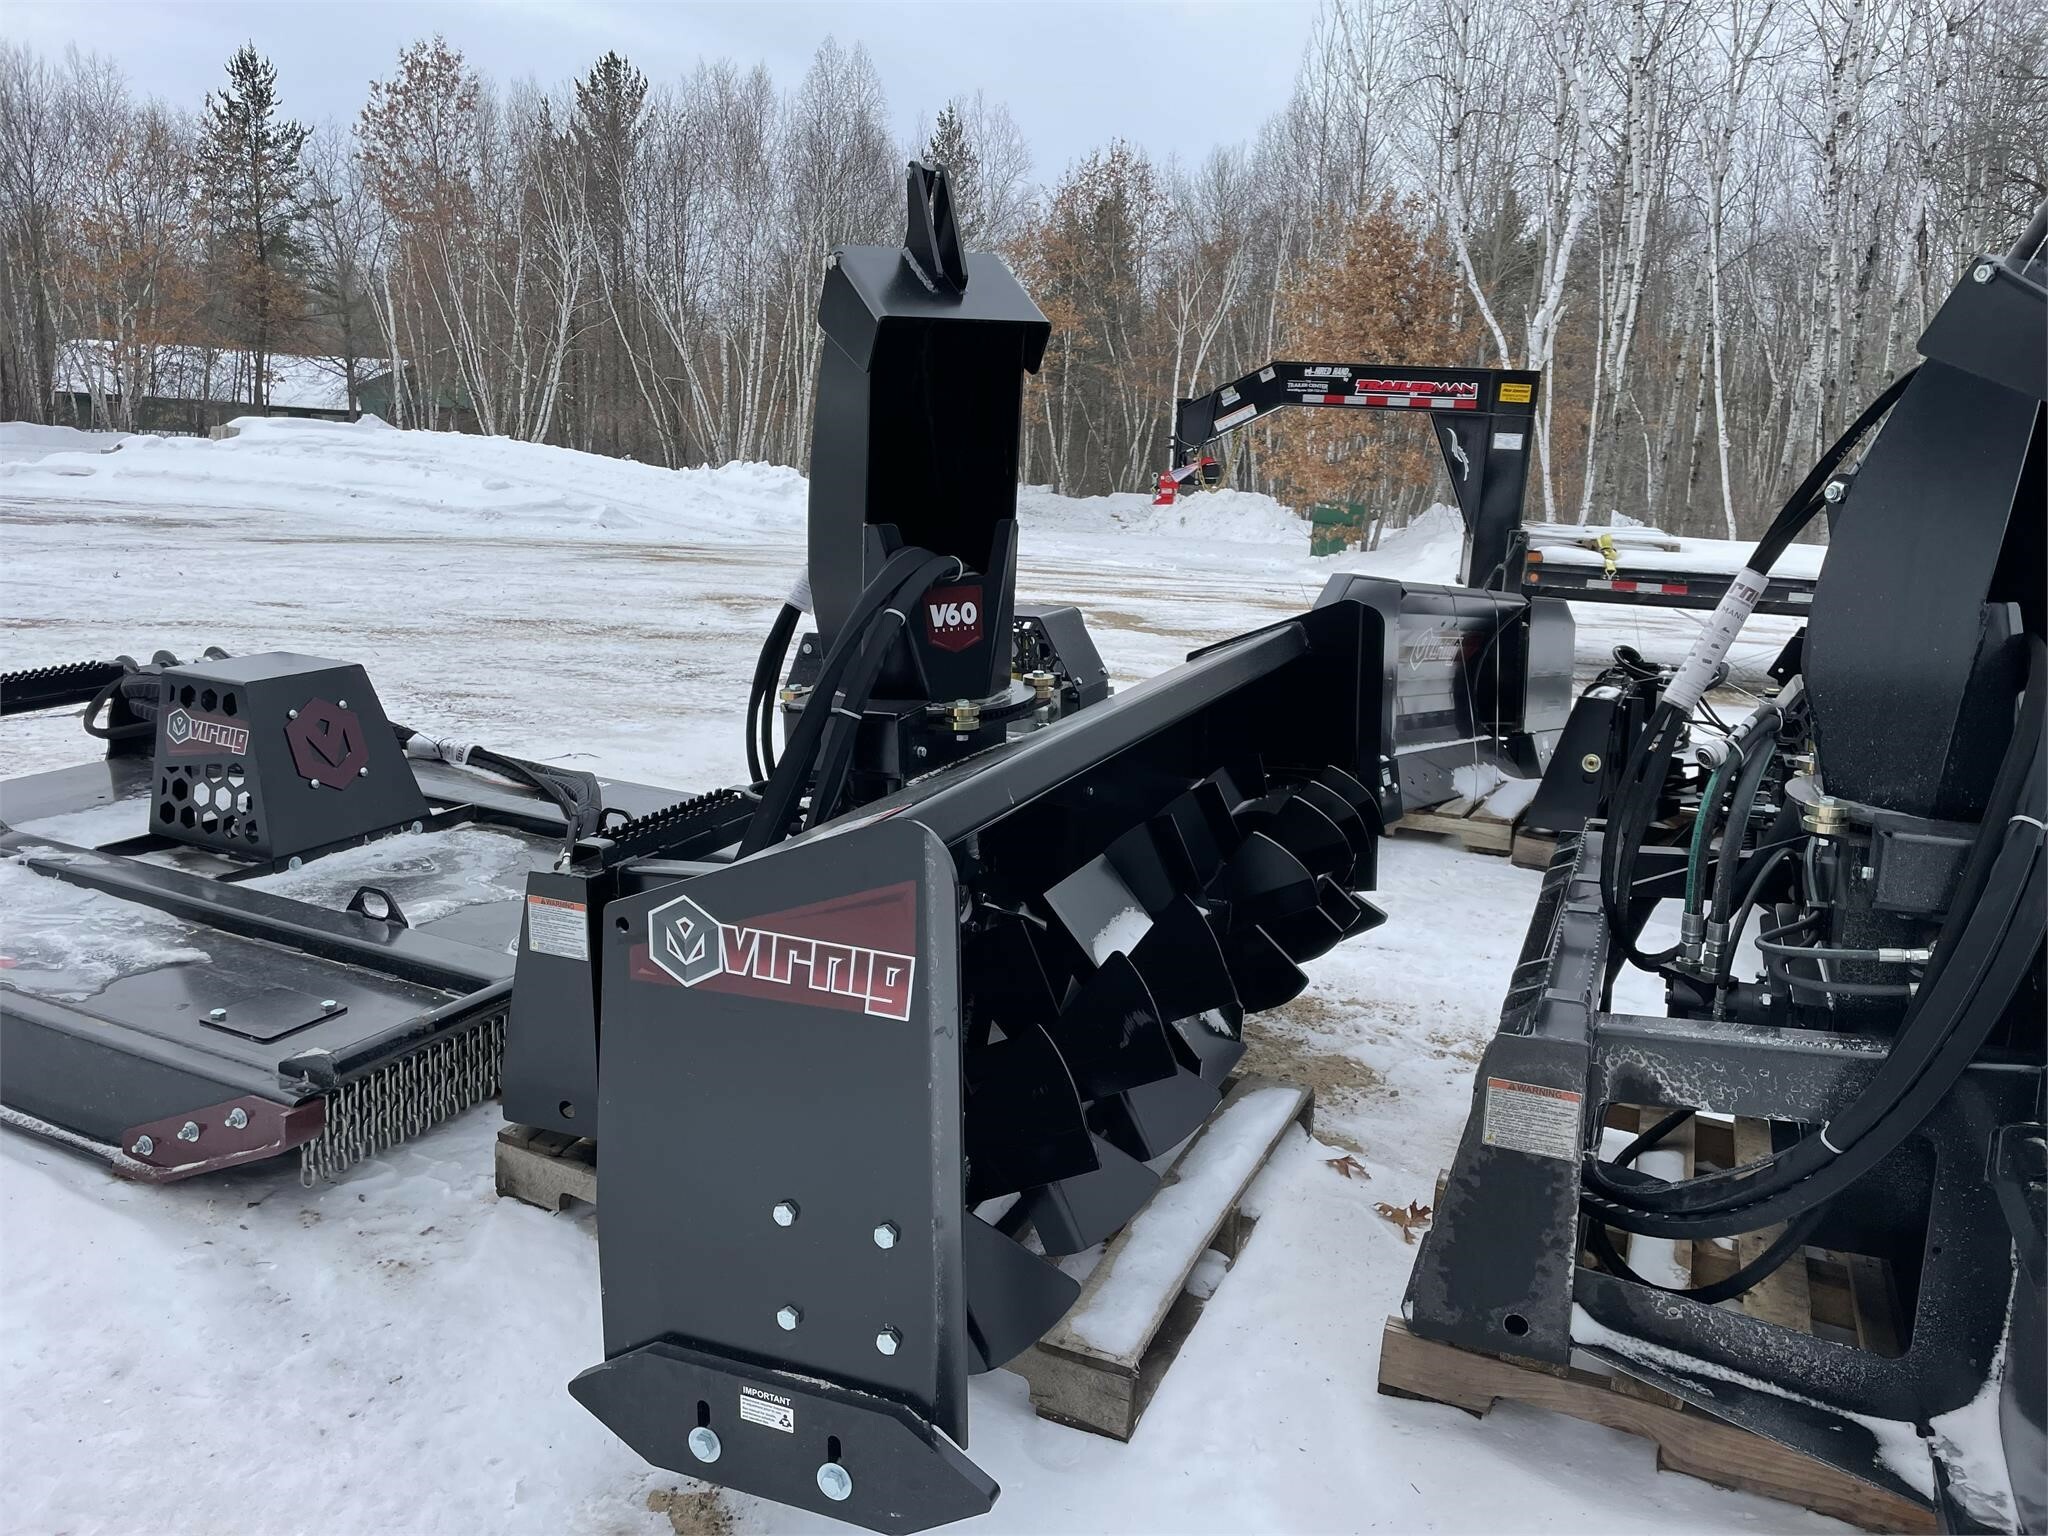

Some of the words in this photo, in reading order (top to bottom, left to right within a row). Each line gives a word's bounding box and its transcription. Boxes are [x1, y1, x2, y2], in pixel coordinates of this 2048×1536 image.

[929, 601, 977, 627] V60
[1517, 1083, 1562, 1099] WARNING
[742, 1386, 791, 1406] IMPORTANT
